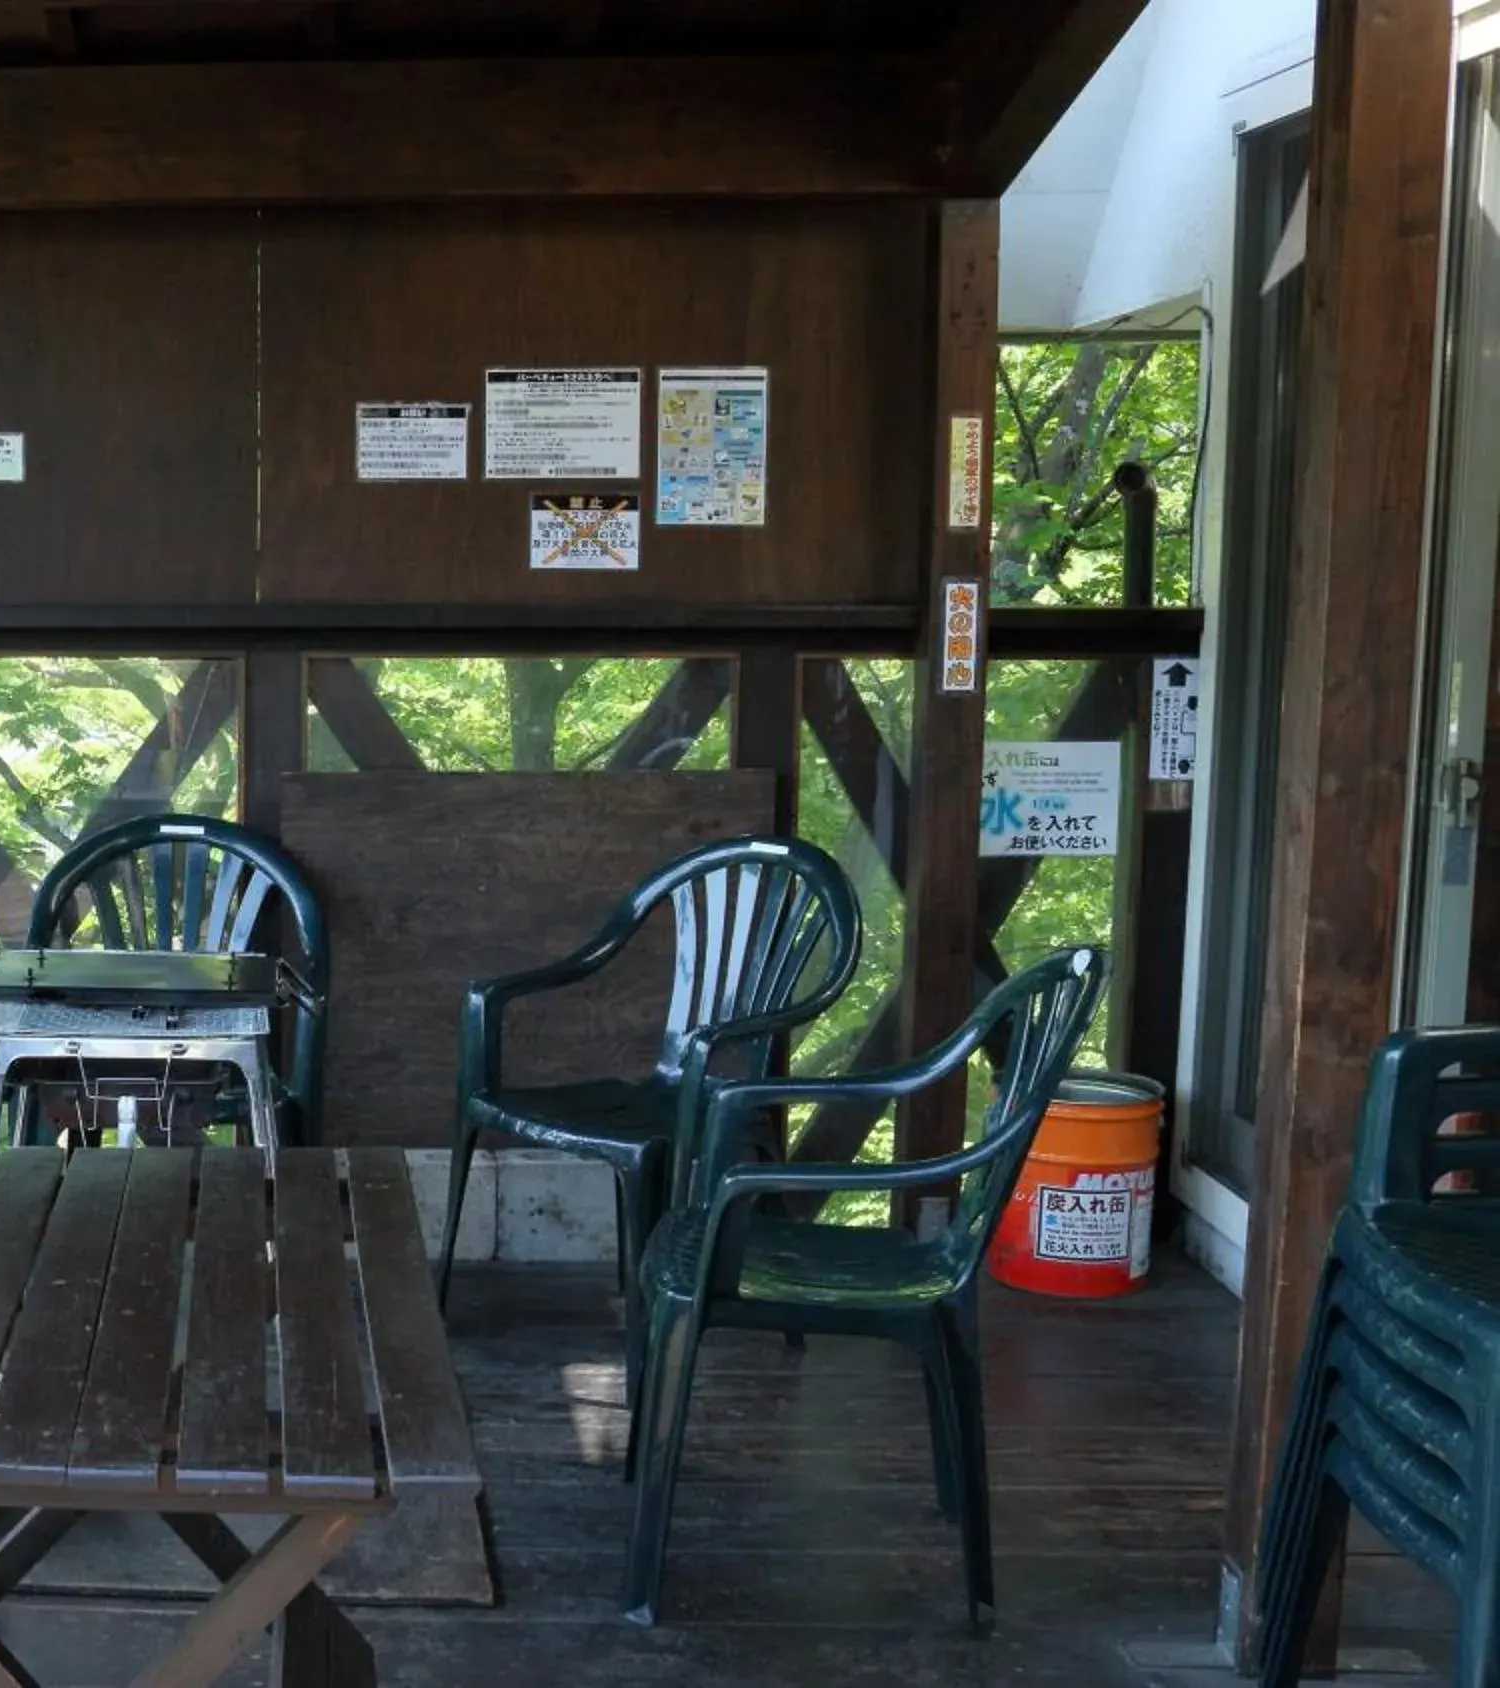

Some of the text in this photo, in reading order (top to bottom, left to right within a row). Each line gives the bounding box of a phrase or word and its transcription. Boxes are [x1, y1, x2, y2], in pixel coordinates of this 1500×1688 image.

[568, 496, 604, 509] 禁止
[947, 586, 975, 686] 火の用心
[980, 787, 1025, 834] 水
[1027, 815, 1098, 832] を入れて
[1009, 835, 1107, 851] お使いください
[1046, 1192, 1126, 1214] 炭入れ缶
[1044, 1239, 1095, 1255] 花火入れ
